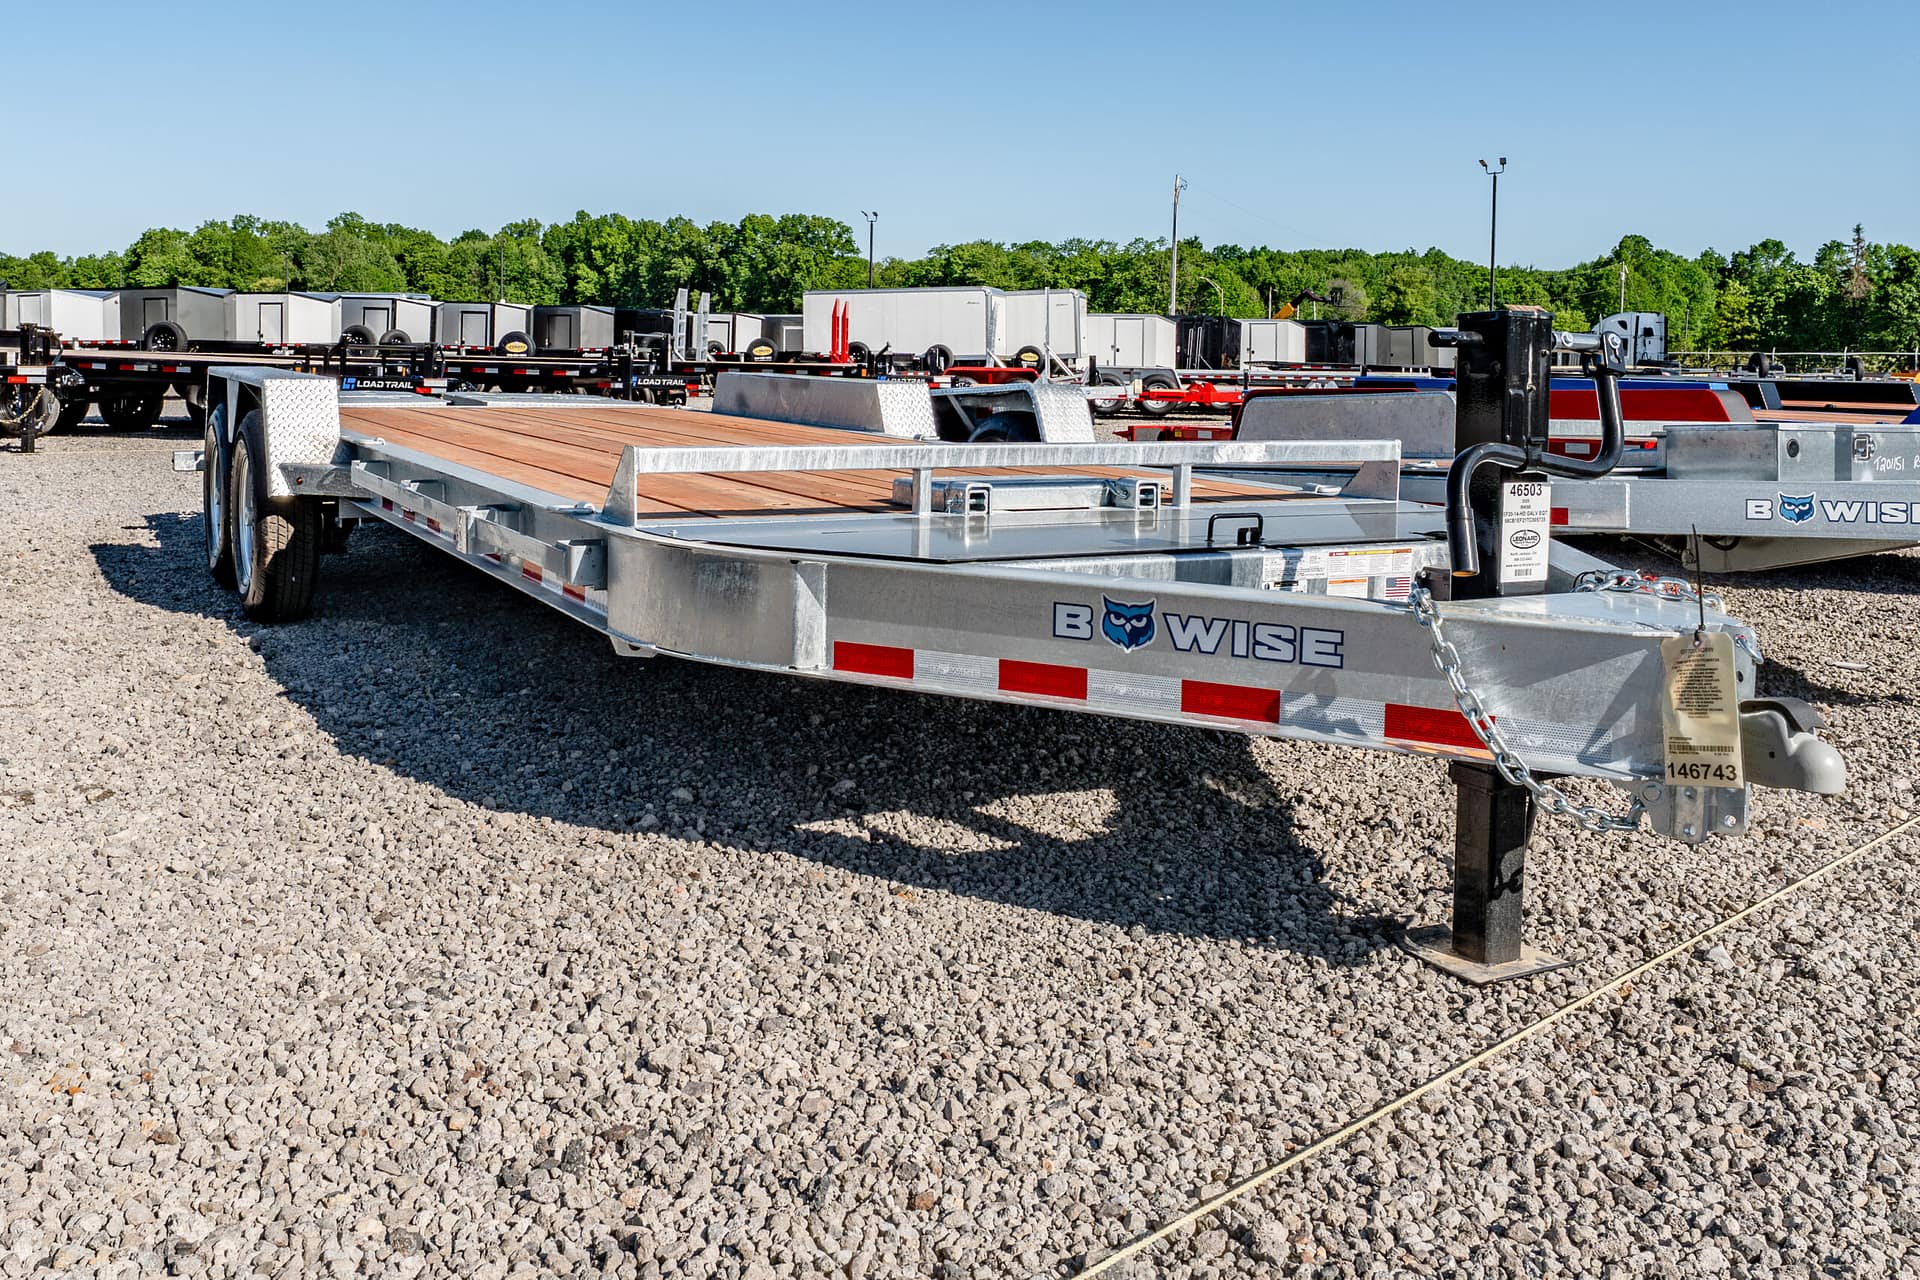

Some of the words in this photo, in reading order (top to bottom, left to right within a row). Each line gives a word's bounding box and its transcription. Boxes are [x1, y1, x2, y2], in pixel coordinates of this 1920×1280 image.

[356, 380, 384, 388] LOAD
[384, 381, 414, 389] TRAIL
[1510, 483, 1543, 496] 46503
[1053, 602, 1093, 640] B
[1162, 612, 1345, 669] WISE
[1667, 762, 1738, 781] 146743
